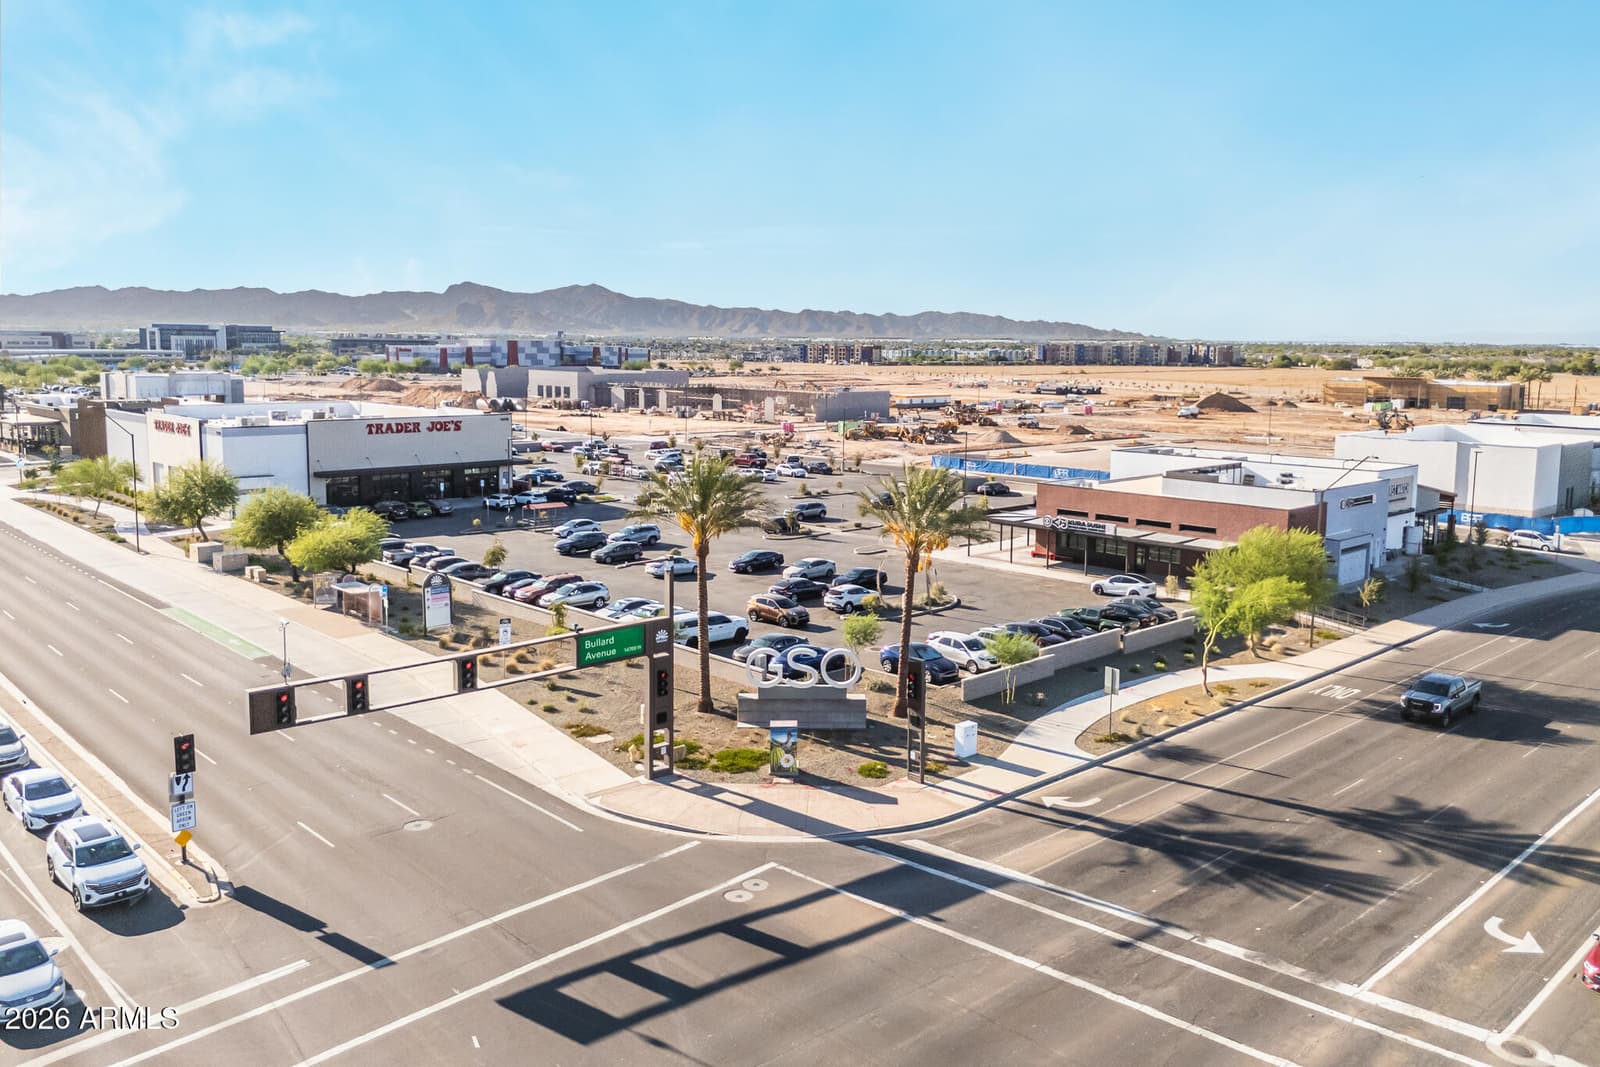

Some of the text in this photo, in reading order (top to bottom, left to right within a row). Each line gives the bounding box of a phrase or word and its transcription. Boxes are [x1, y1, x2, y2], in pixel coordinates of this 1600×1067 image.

[366, 420, 462, 435] TRADER JOE'S
[1068, 519, 1086, 527] KURA
[585, 635, 615, 649] Bullard
[585, 648, 617, 660] Avenue
[1308, 684, 1362, 699] ONLY
